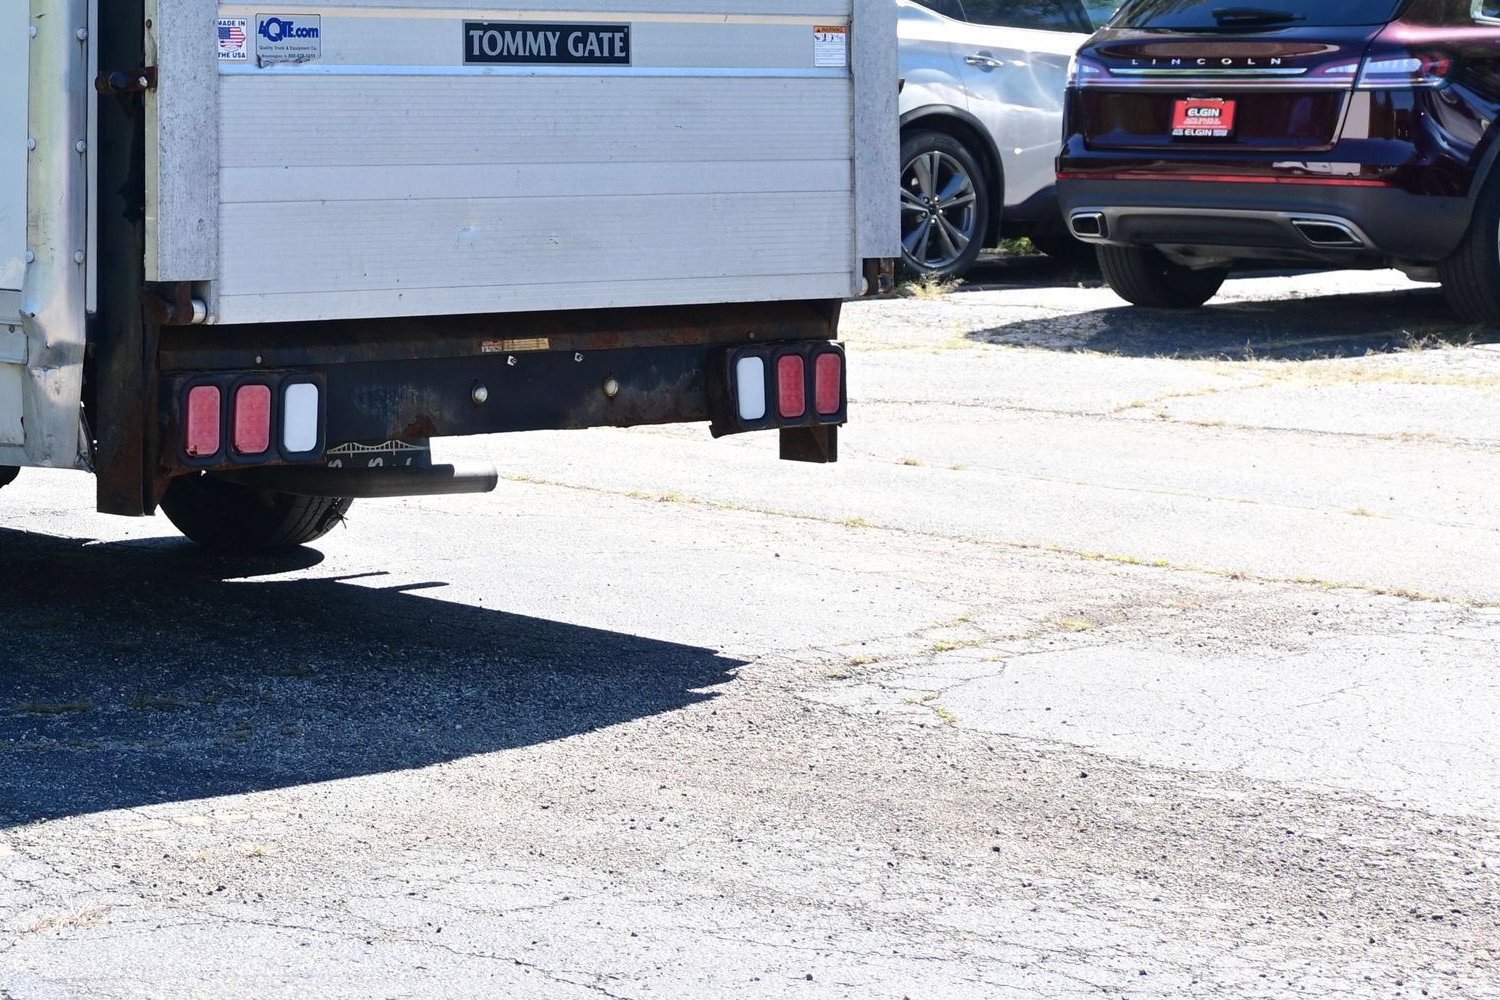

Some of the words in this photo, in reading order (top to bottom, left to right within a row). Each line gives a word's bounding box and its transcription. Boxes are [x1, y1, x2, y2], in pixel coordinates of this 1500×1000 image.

[469, 30, 560, 56] TOMMY
[567, 31, 627, 57] GATE
[1187, 108, 1220, 117] ELGIN
